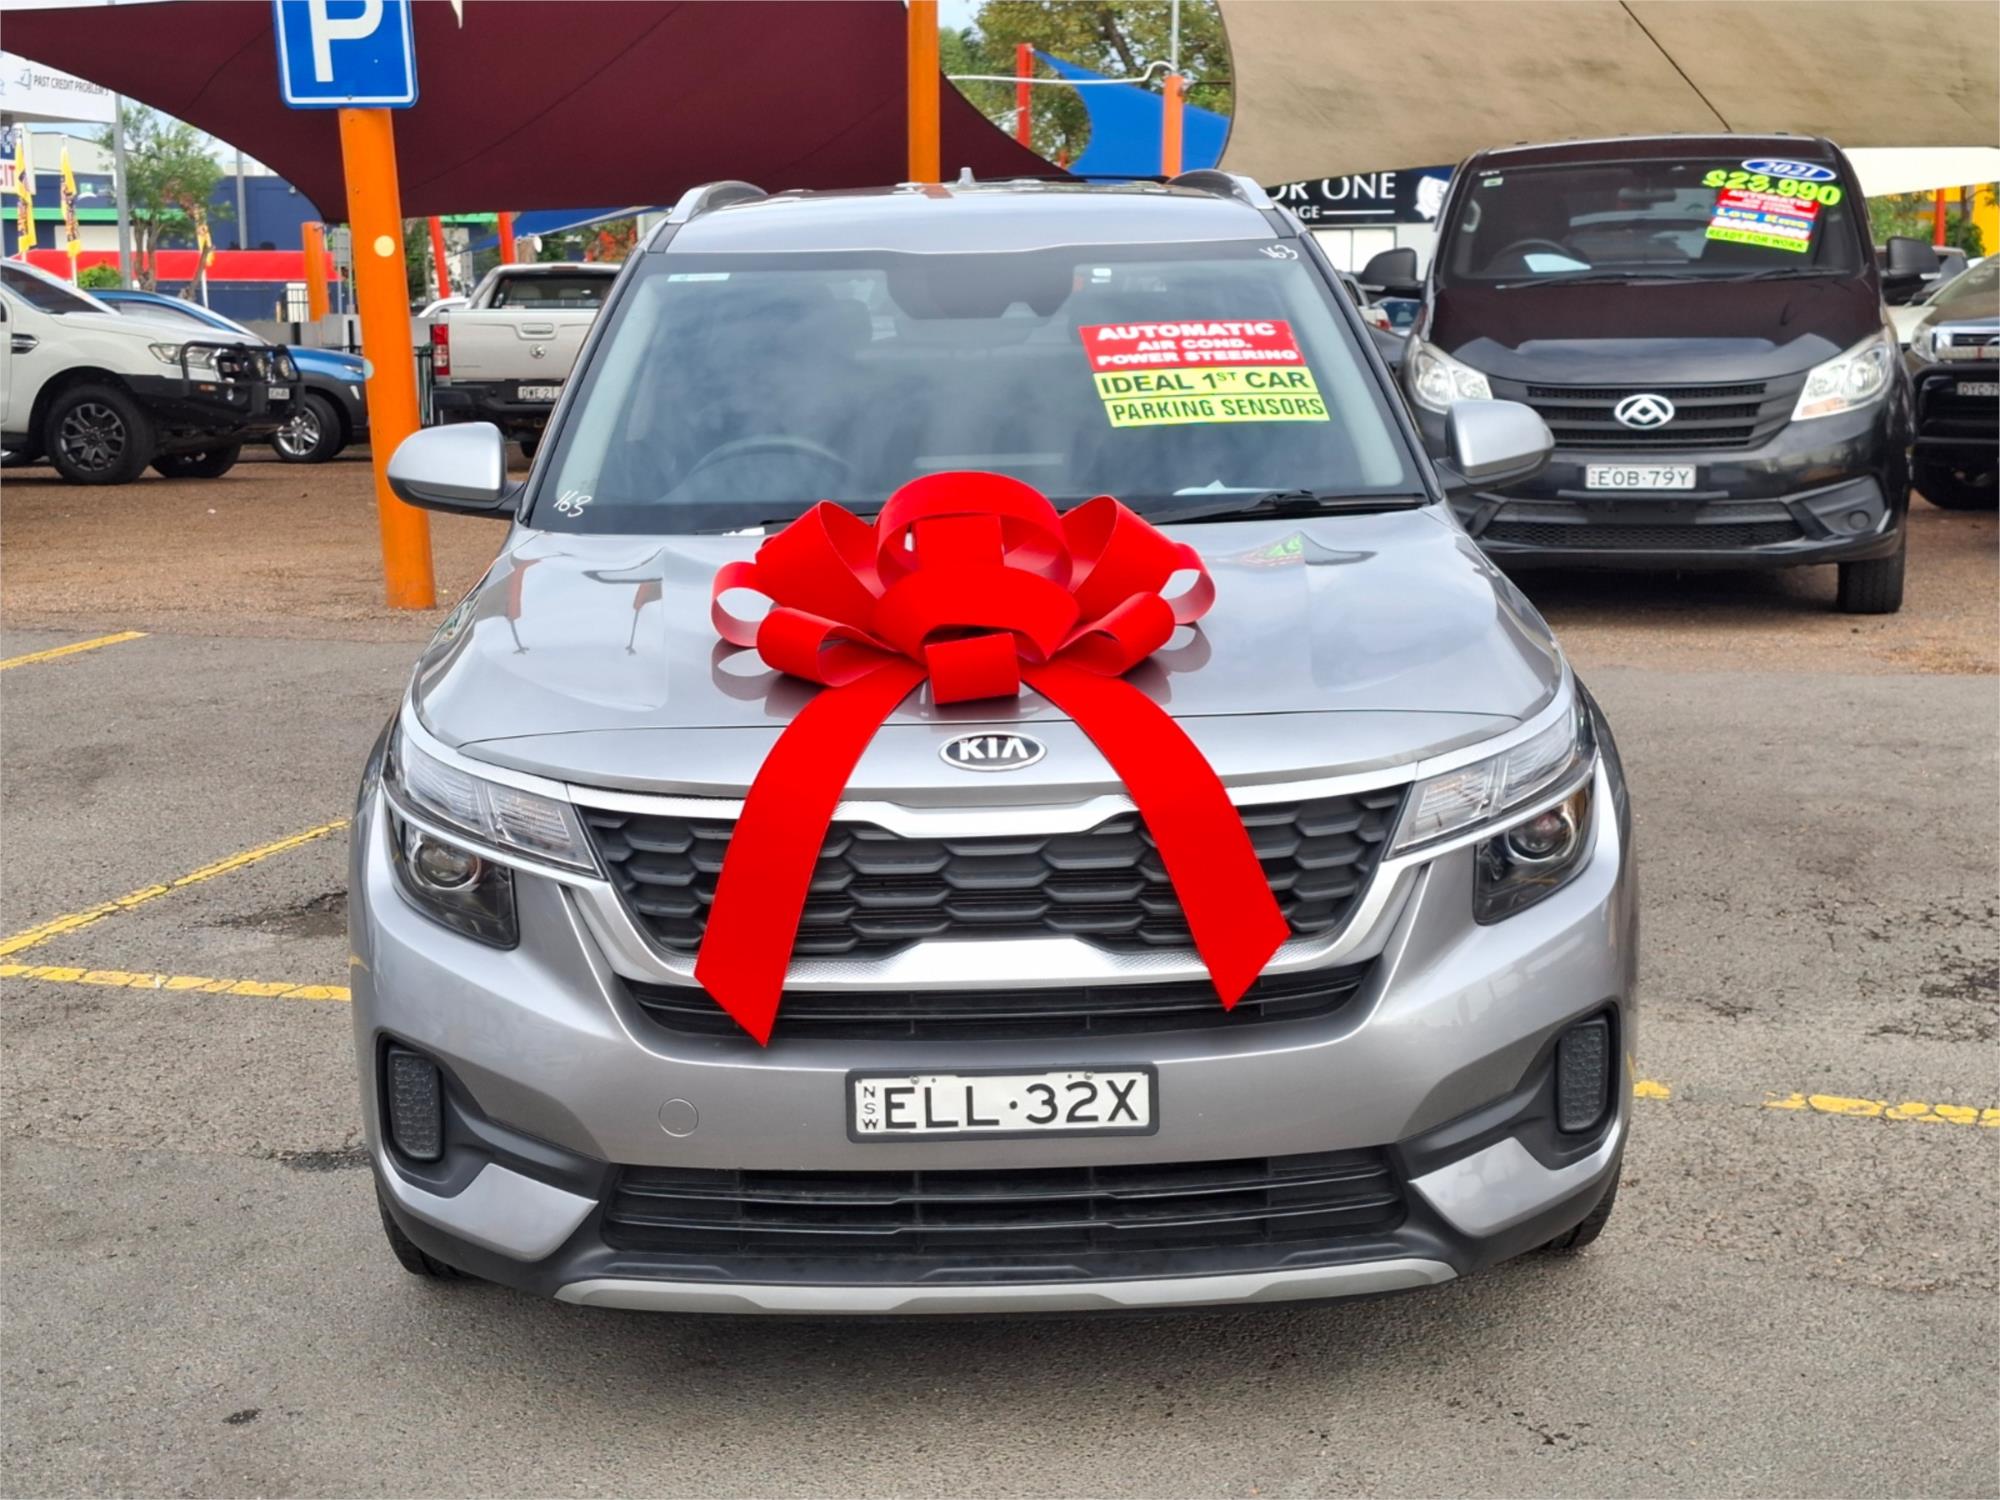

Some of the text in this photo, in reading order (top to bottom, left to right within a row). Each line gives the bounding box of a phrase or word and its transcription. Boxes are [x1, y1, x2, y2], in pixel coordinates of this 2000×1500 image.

[308, 0, 384, 82] P
[33, 74, 50, 87] PAST
[51, 77, 74, 90] CREDIT
[1758, 161, 1821, 177] 2021
[1321, 172, 1396, 200] ONE
[1716, 207, 1759, 220] Low
[1708, 228, 1803, 248] READY FOR WORK
[1097, 322, 1276, 340] AUTOMATIC
[1137, 338, 1252, 351] AIR COND.
[1097, 349, 1298, 365] POWER STEERING
[1101, 371, 1310, 394] IDEAL 1ST CAR
[1112, 398, 1325, 421] PARKING SENSORS
[553, 490, 592, 517] 163
[959, 737, 1029, 760] KIA
[863, 1086, 879, 1130] NSW
